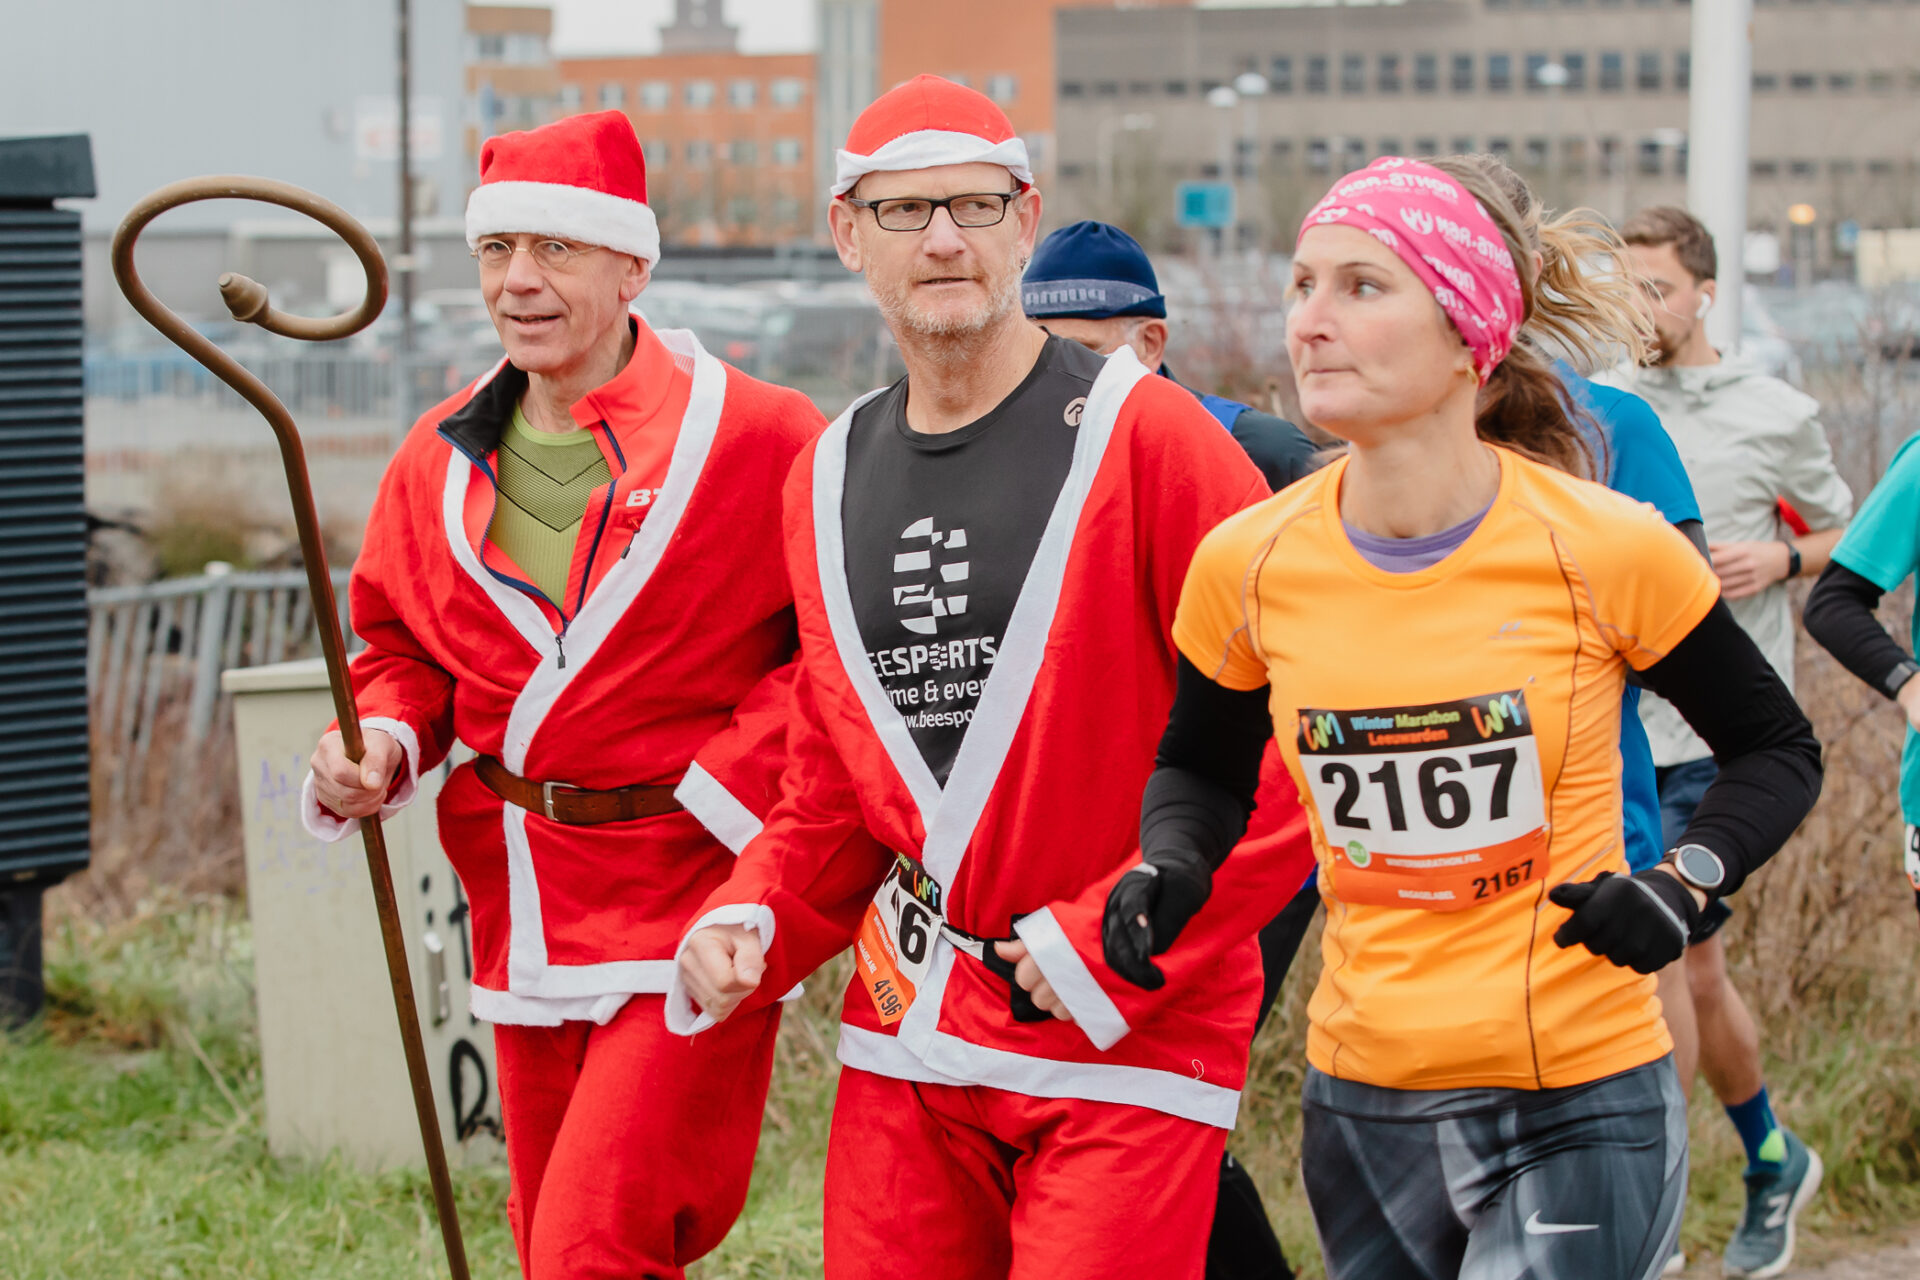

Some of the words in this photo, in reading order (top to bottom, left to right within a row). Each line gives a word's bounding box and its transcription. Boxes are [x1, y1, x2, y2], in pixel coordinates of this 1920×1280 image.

[924, 680, 939, 702] &
[1349, 715, 1394, 731] Winter
[1395, 709, 1461, 729] Marathon
[1320, 747, 1518, 832] 2167
[1472, 858, 1534, 900] 2167
[873, 978, 903, 1018] 4196
